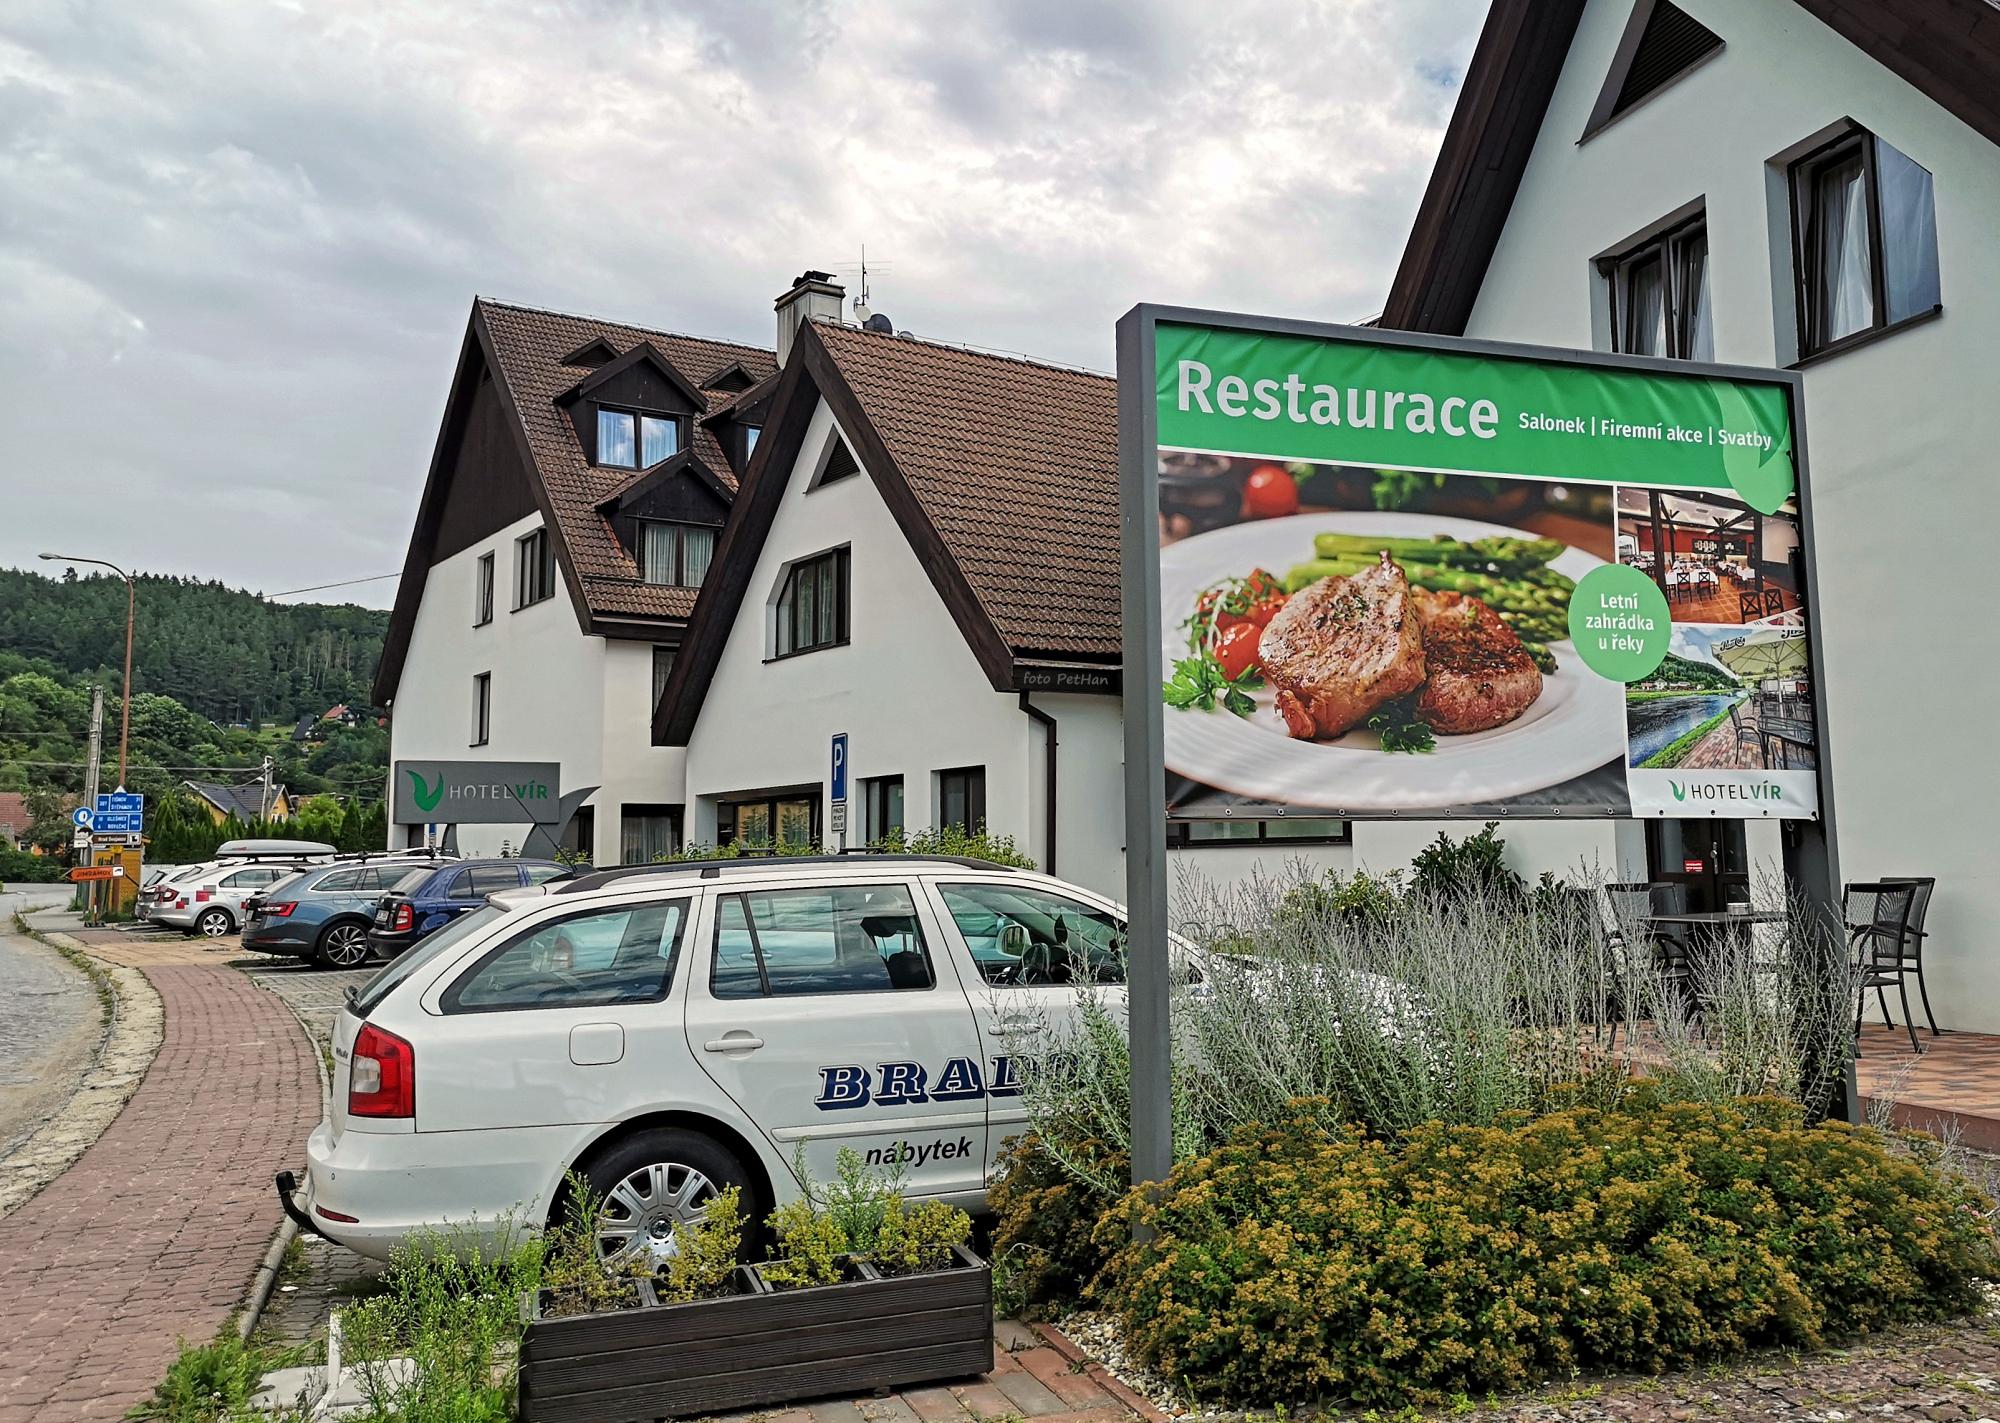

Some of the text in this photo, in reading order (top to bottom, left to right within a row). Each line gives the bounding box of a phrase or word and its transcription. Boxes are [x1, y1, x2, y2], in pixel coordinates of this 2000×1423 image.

[1177, 358, 1500, 439] Restaurace
[1518, 412, 1772, 453] Salonek Firemní akce Svatby
[1600, 593, 1638, 610] Letní
[1585, 612, 1655, 632] zahrádka
[1598, 635, 1645, 655] u řeky
[833, 743, 843, 782] P
[865, 1135, 974, 1168] nábytek
